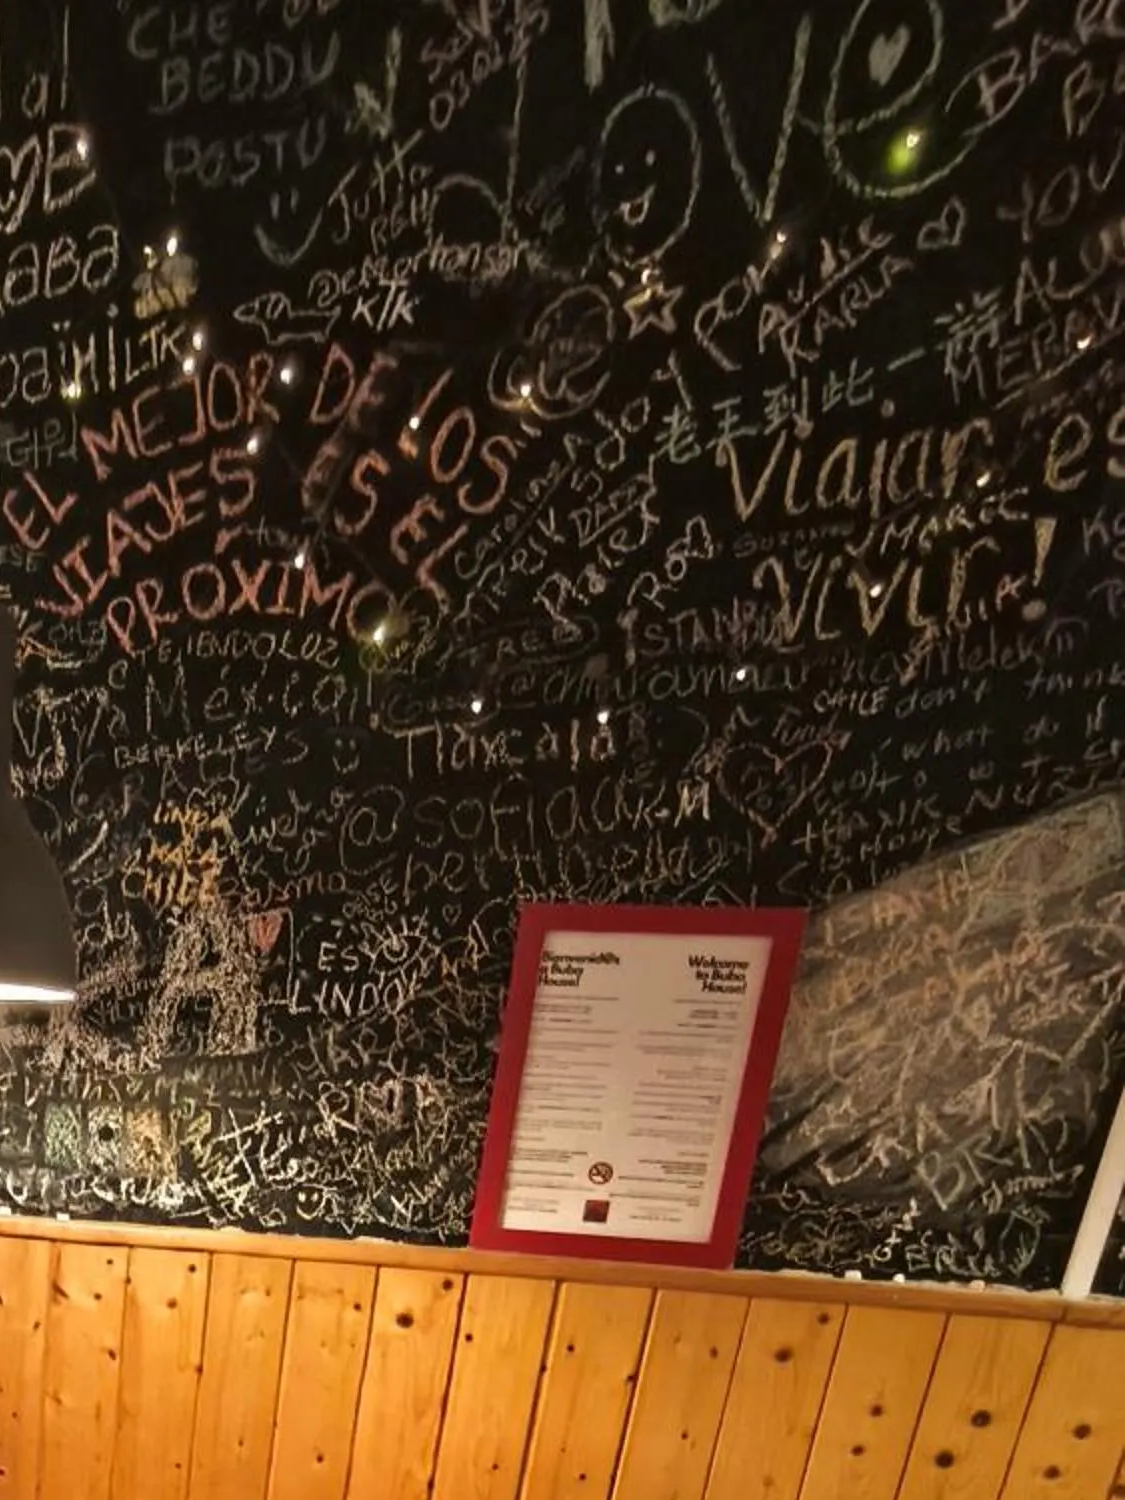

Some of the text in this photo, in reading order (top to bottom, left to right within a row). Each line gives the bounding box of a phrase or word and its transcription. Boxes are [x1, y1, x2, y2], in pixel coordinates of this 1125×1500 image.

[80, 348, 280, 484] MEJOR
[713, 400, 995, 522] Viajar
[688, 954, 749, 970] Welcome
[695, 969, 710, 982] to
[701, 980, 748, 996] House!
